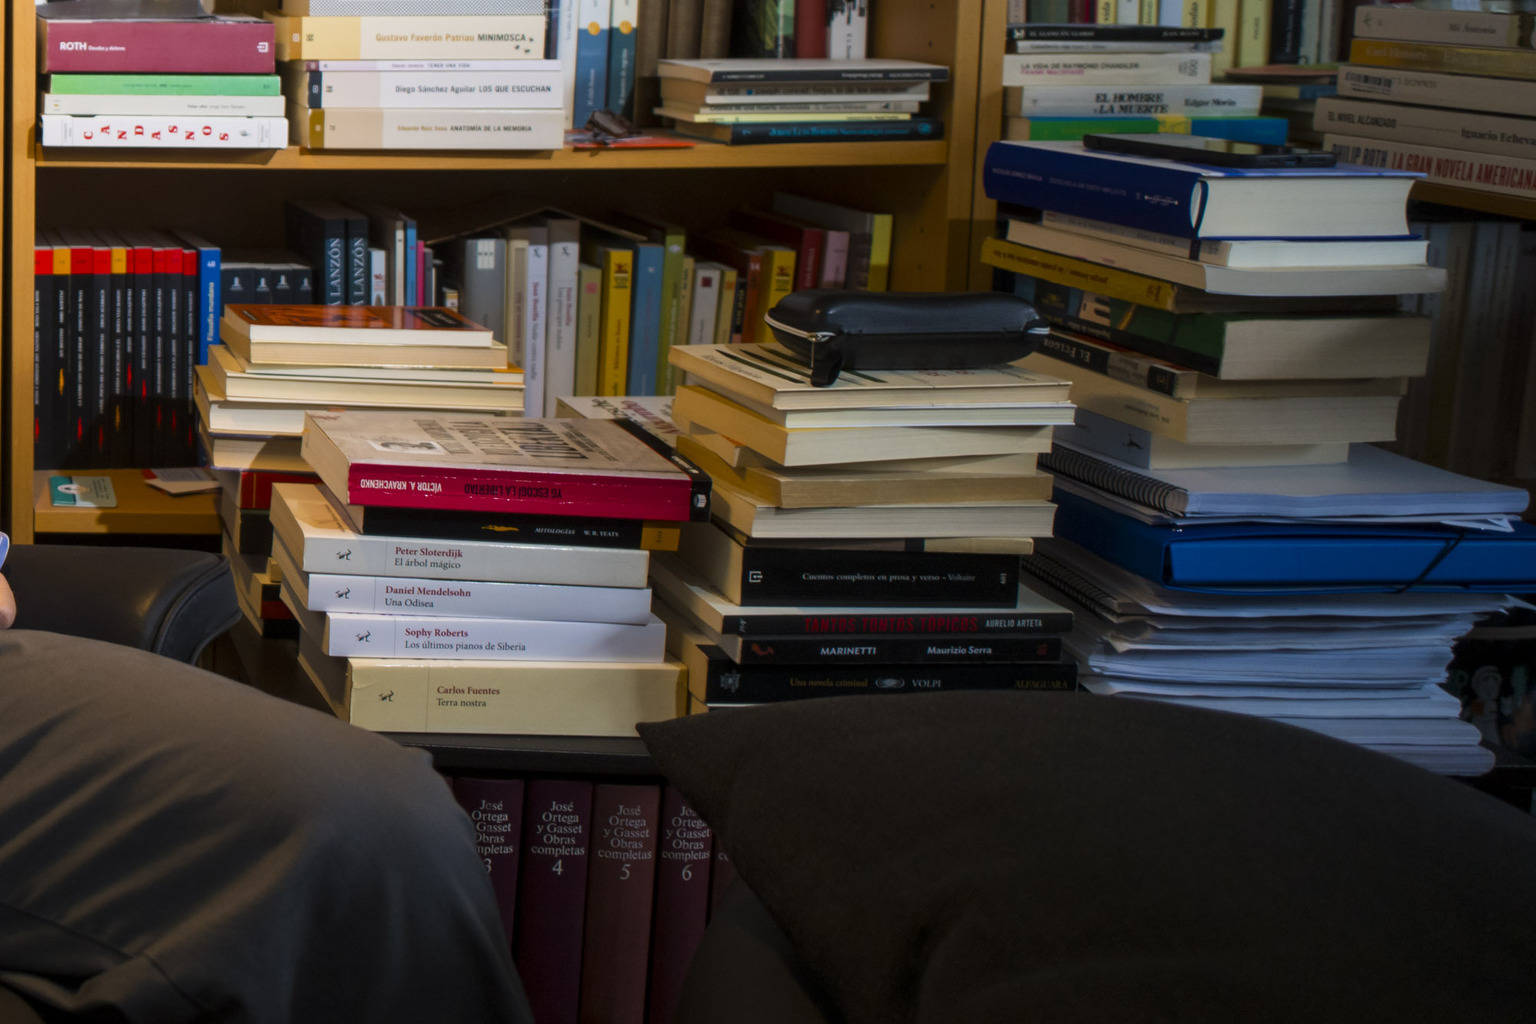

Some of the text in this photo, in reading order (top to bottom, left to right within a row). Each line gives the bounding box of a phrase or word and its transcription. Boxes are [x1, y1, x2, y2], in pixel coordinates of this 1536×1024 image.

[376, 33, 526, 42] Gustavo Faverón Patriau MINIMOSCA
[60, 42, 86, 50] ROTH
[395, 85, 415, 95] Diego
[418, 84, 448, 93] Sánchez
[451, 85, 475, 94] Aguilar
[495, 86, 509, 94] QUE
[1095, 94, 1163, 103] EL HOMBRE
[1099, 104, 1168, 114] LA MUERTE
[1362, 149, 1388, 167] ROTH
[1390, 152, 1408, 169] LA
[1409, 154, 1435, 173] GRAN
[1436, 159, 1473, 180] NOVELA
[1475, 163, 1536, 190] AMERICANA
[327, 238, 341, 297] LANZÓN
[360, 479, 442, 493] VÍCTOR A. KRAVCHENKO
[464, 483, 562, 498] YO ESCOGÍ LA LIBERTAD
[395, 547, 463, 559] Peter Sloterdijk
[394, 558, 461, 570] El árbol mágico
[802, 572, 832, 581] Cuentos
[836, 572, 875, 582] completos
[888, 574, 908, 582] prosa
[385, 586, 471, 597] Daniel Mendelsohn
[385, 598, 434, 608] Una Odisea
[804, 614, 1042, 632] TANTOS TONTOS TÓPICOS AURELIO ARTETA
[405, 628, 468, 639] Sophy Roberts
[405, 641, 525, 653] Los últimos pianos de Siberia
[820, 646, 992, 655] MARINETTI Maurizio Serra
[790, 678, 942, 687] Una novela criminal VOLPI
[437, 685, 500, 695] Carlos Fuentes
[436, 698, 486, 707] Terra nostra
[550, 801, 574, 812] José
[617, 805, 641, 815] José
[542, 812, 579, 823] Ortega
[609, 816, 646, 827] Ortega
[537, 823, 582, 834] y Gasset
[603, 827, 650, 838] y Gasset
[543, 834, 576, 844] Obras
[610, 838, 643, 848] Obras
[531, 845, 585, 855] completas
[598, 849, 652, 860] completas
[552, 859, 563, 875] 4
[620, 863, 631, 880] 5
